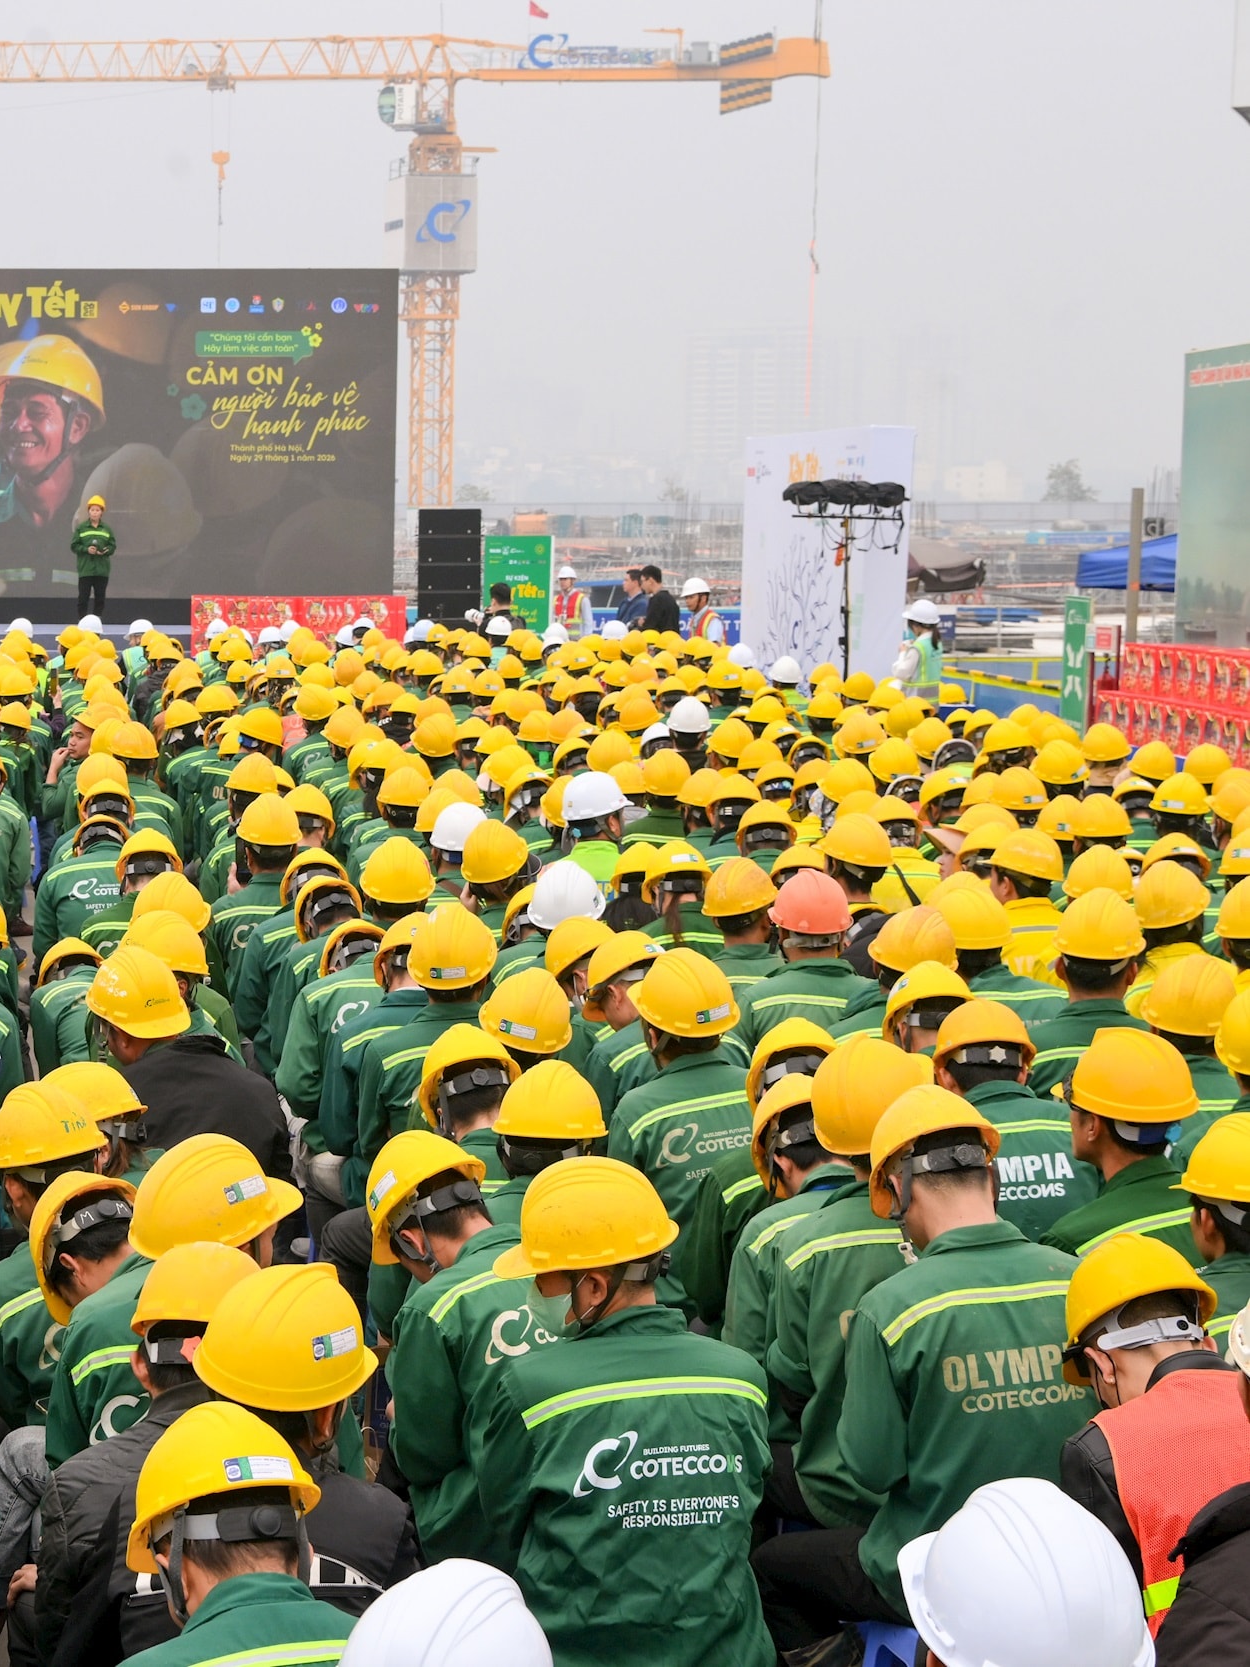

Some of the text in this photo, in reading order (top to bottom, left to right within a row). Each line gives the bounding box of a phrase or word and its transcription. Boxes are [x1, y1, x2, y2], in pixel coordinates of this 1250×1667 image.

[397, 87, 405, 120] POTAIN
[26, 280, 79, 318] Tết
[244, 333, 255, 341] tôi
[276, 333, 292, 343] bạn
[203, 344, 221, 354] Hãy
[223, 344, 240, 352] làm
[241, 343, 258, 354] việc
[186, 360, 283, 385] CẢM ƠN
[211, 376, 360, 430] người bảo vệ
[242, 409, 370, 451] hạnh phúc
[230, 443, 255, 452] Thành
[257, 443, 272, 454] phố
[274, 444, 286, 452] Hà
[230, 454, 251, 464] Ngày
[265, 454, 289, 464] tháng
[297, 454, 315, 462] năm
[317, 454, 336, 462] 2026
[514, 574, 529, 582] KIỆN
[517, 581, 538, 598] Tết
[695, 1133, 753, 1154] COTECC
[995, 1152, 1075, 1184] MPIA
[998, 1182, 1066, 1202] ECCONS
[79, 1210, 95, 1225] M
[116, 1202, 129, 1215] M
[942, 1342, 1068, 1393] OLYMP
[961, 1383, 1086, 1414] COTECCONS
[643, 1443, 710, 1456] BUILDING FUTURES
[630, 1453, 743, 1480] COTECCONS
[607, 1495, 739, 1518] SAFETY IS EVERYONE'S
[622, 1511, 723, 1529] RESPONSIBILITY
